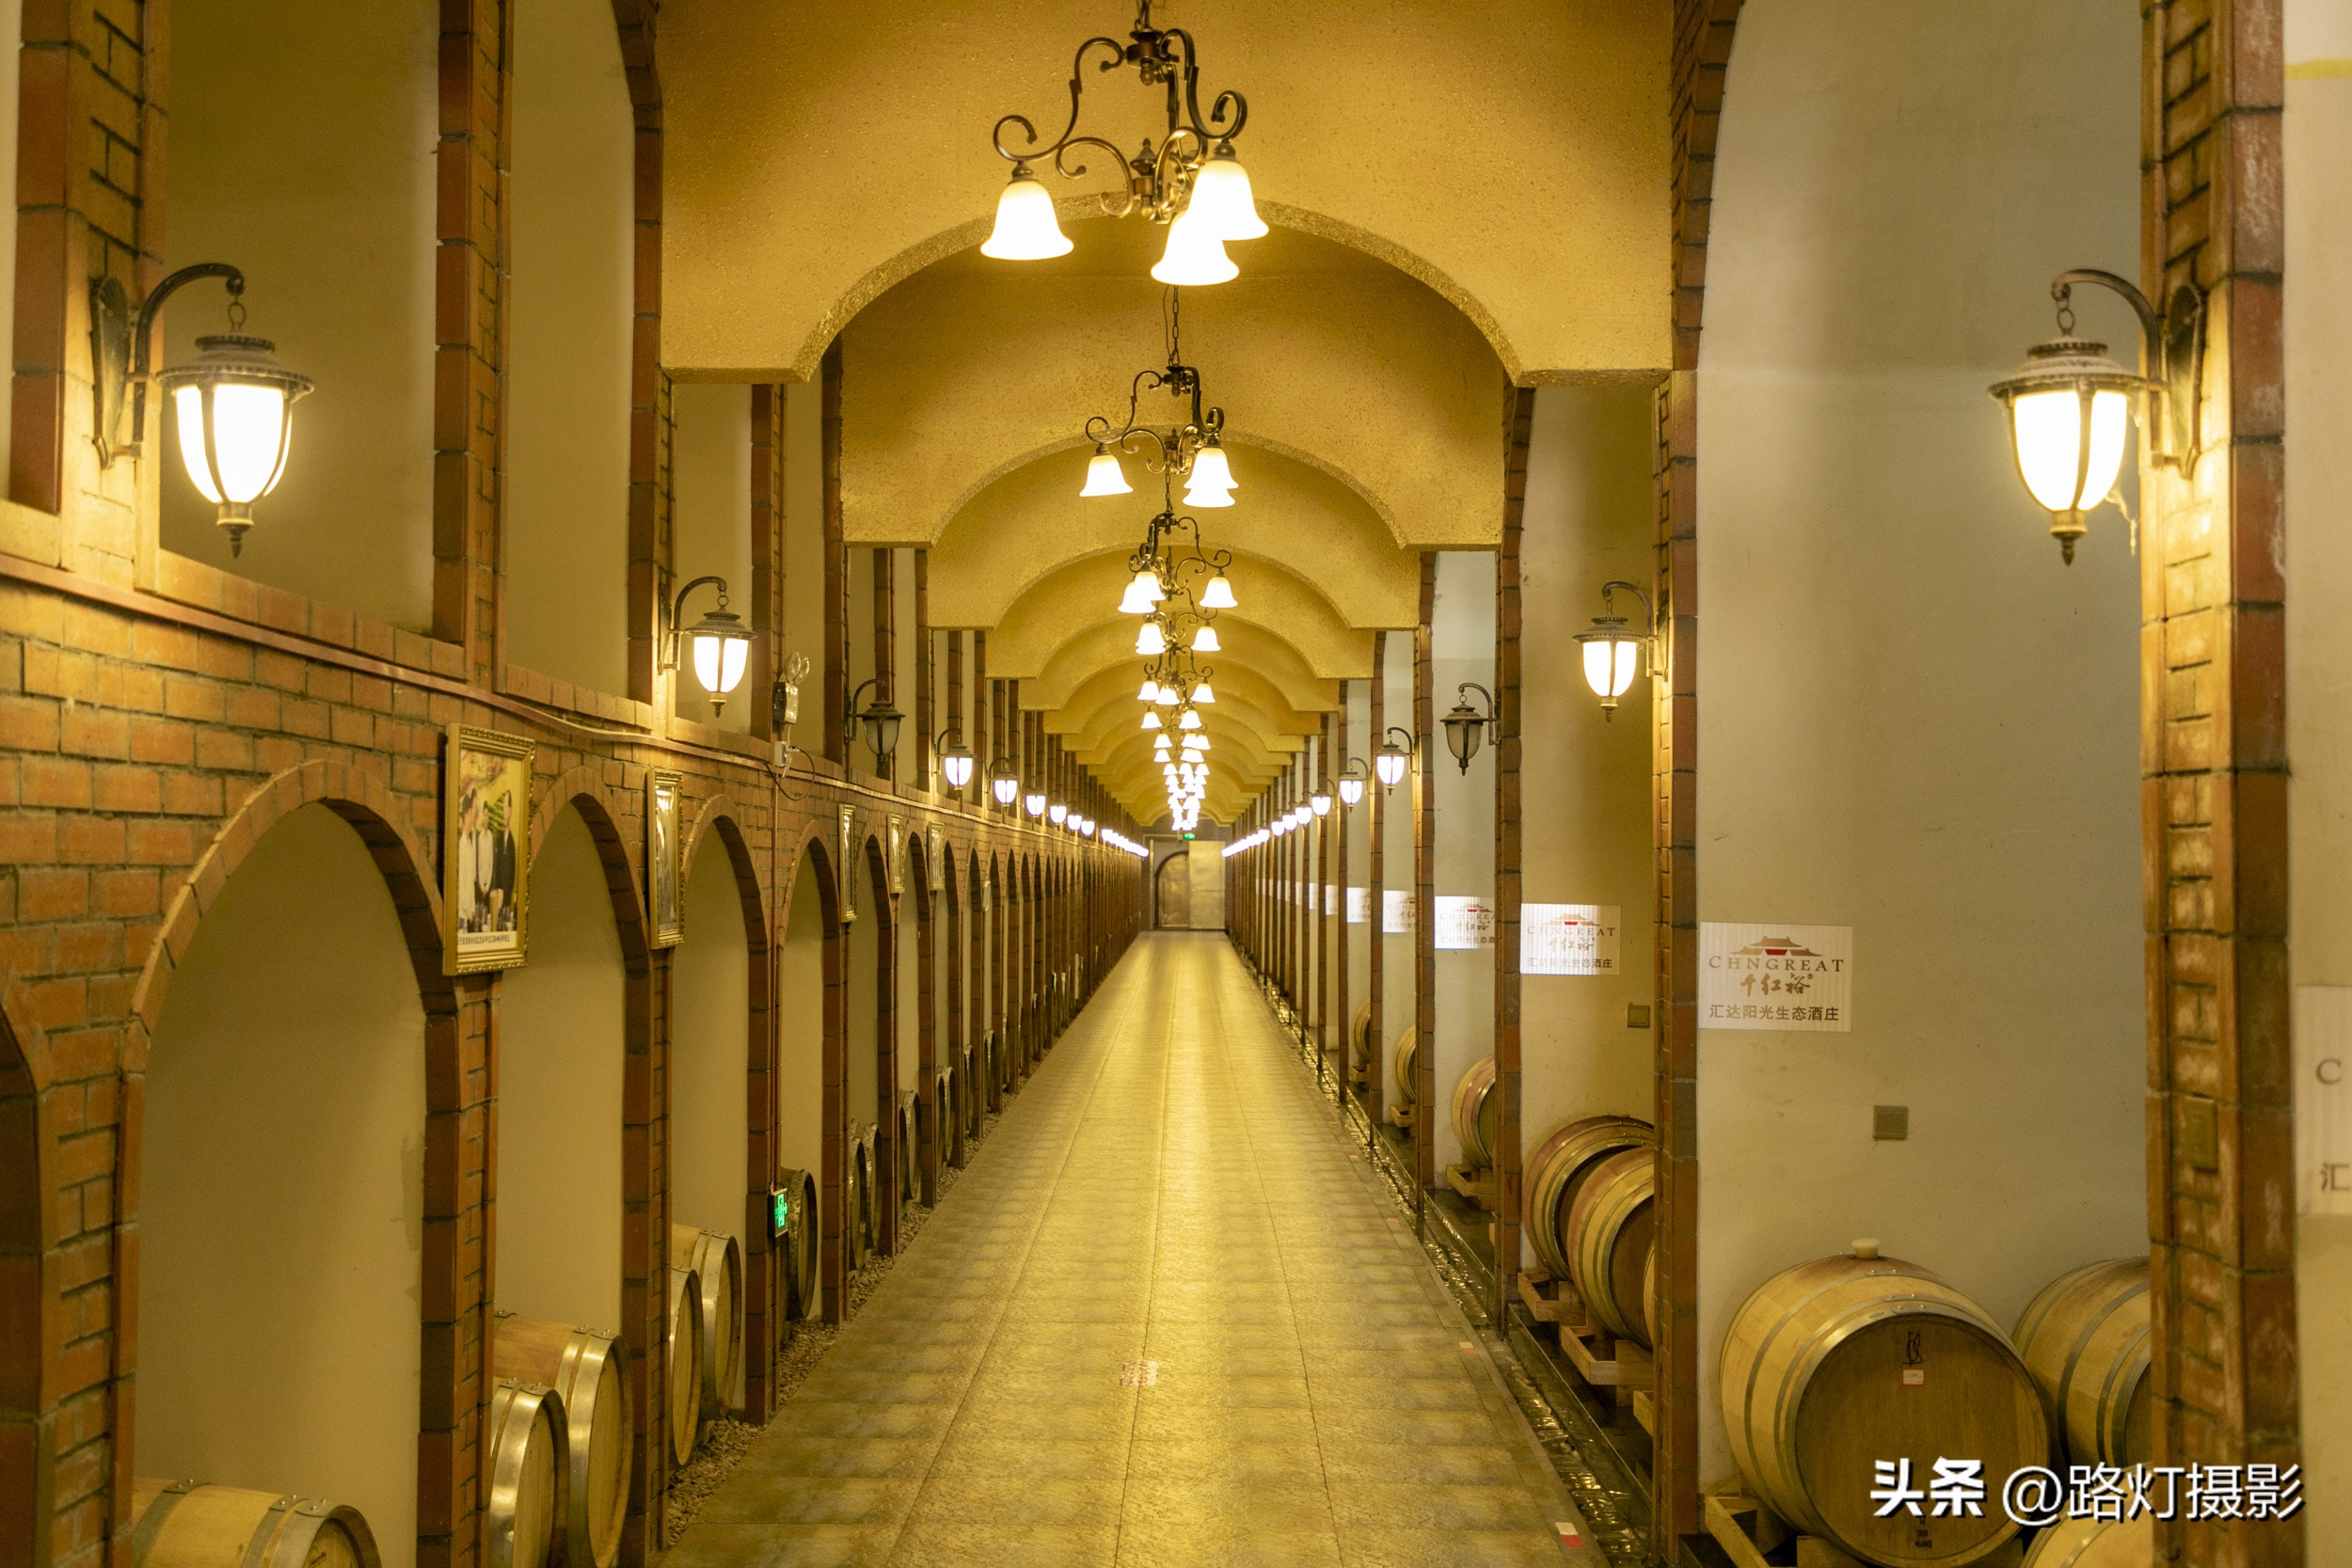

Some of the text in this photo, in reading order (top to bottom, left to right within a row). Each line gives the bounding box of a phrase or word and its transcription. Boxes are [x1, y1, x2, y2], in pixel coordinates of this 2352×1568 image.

[1527, 926, 1615, 936] CHNGREAT
[1708, 956, 1844, 973] CHNGREAT
[1709, 1004, 1839, 1022] 汇达阳光生态酒庄
